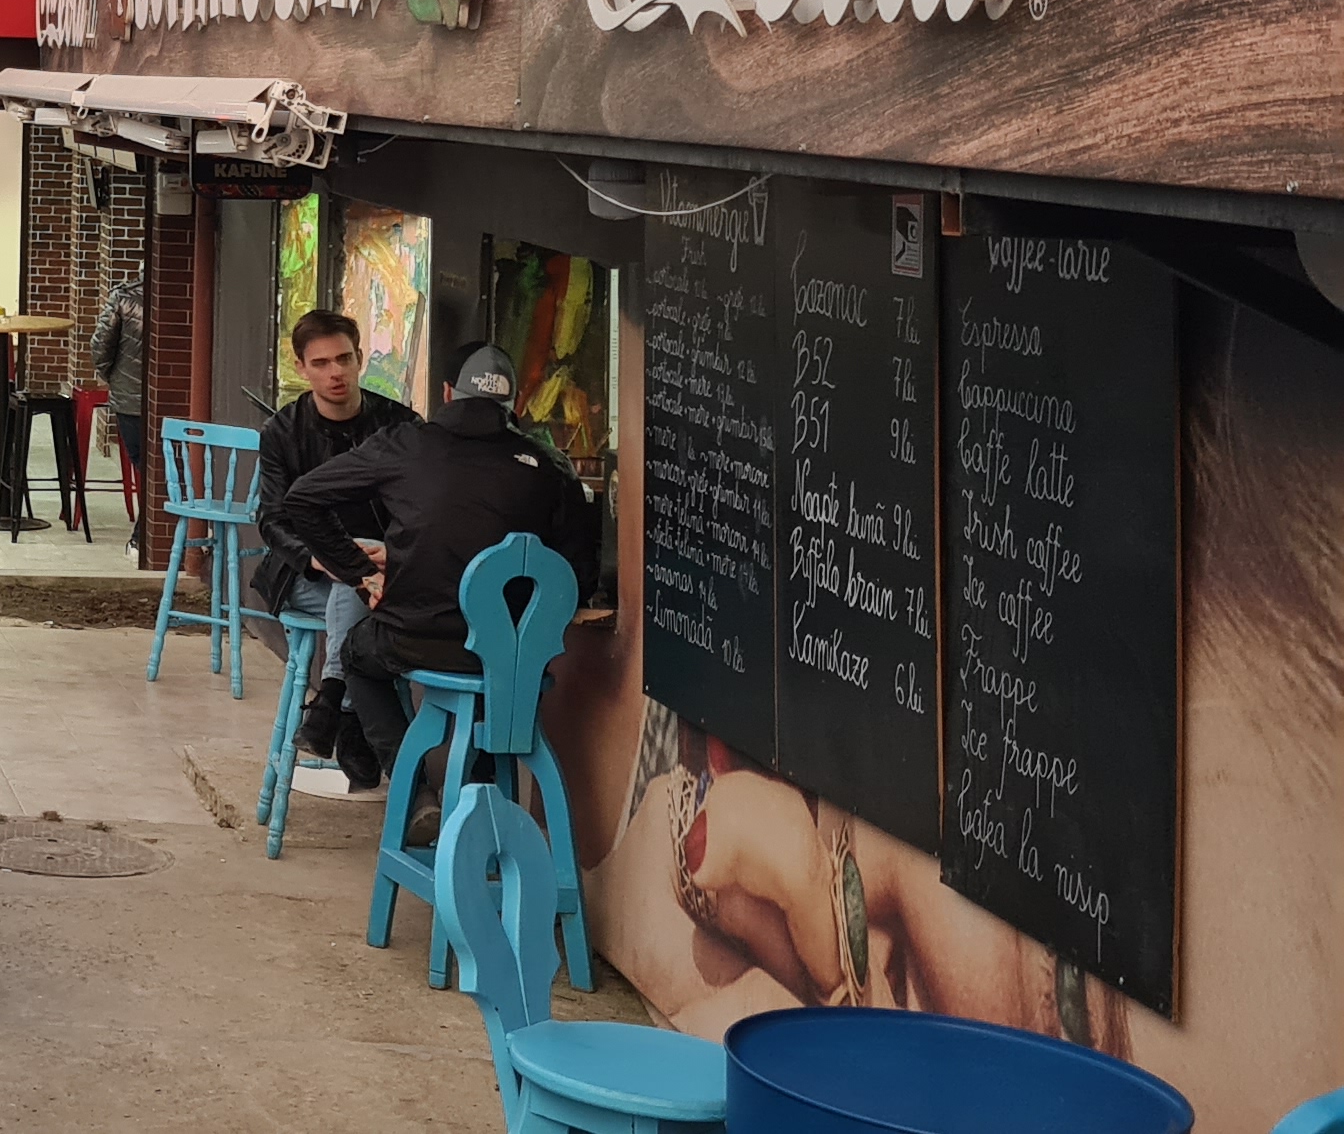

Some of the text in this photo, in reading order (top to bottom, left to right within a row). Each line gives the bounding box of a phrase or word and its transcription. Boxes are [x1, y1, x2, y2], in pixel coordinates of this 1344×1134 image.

[214, 163, 288, 179] KAFUNE
[958, 296, 1043, 374] Espresso
[791, 457, 840, 551] Noapte
[1024, 438, 1075, 508] latte
[789, 526, 841, 609] Buffalo
[844, 546, 898, 622] brain
[962, 489, 1083, 597] Irish coffee
[962, 554, 1054, 664] Ice coffee
[960, 623, 1039, 737] Frappe
[961, 699, 1079, 819] Ice frappe
[957, 768, 1111, 964] Cafea la nisip
